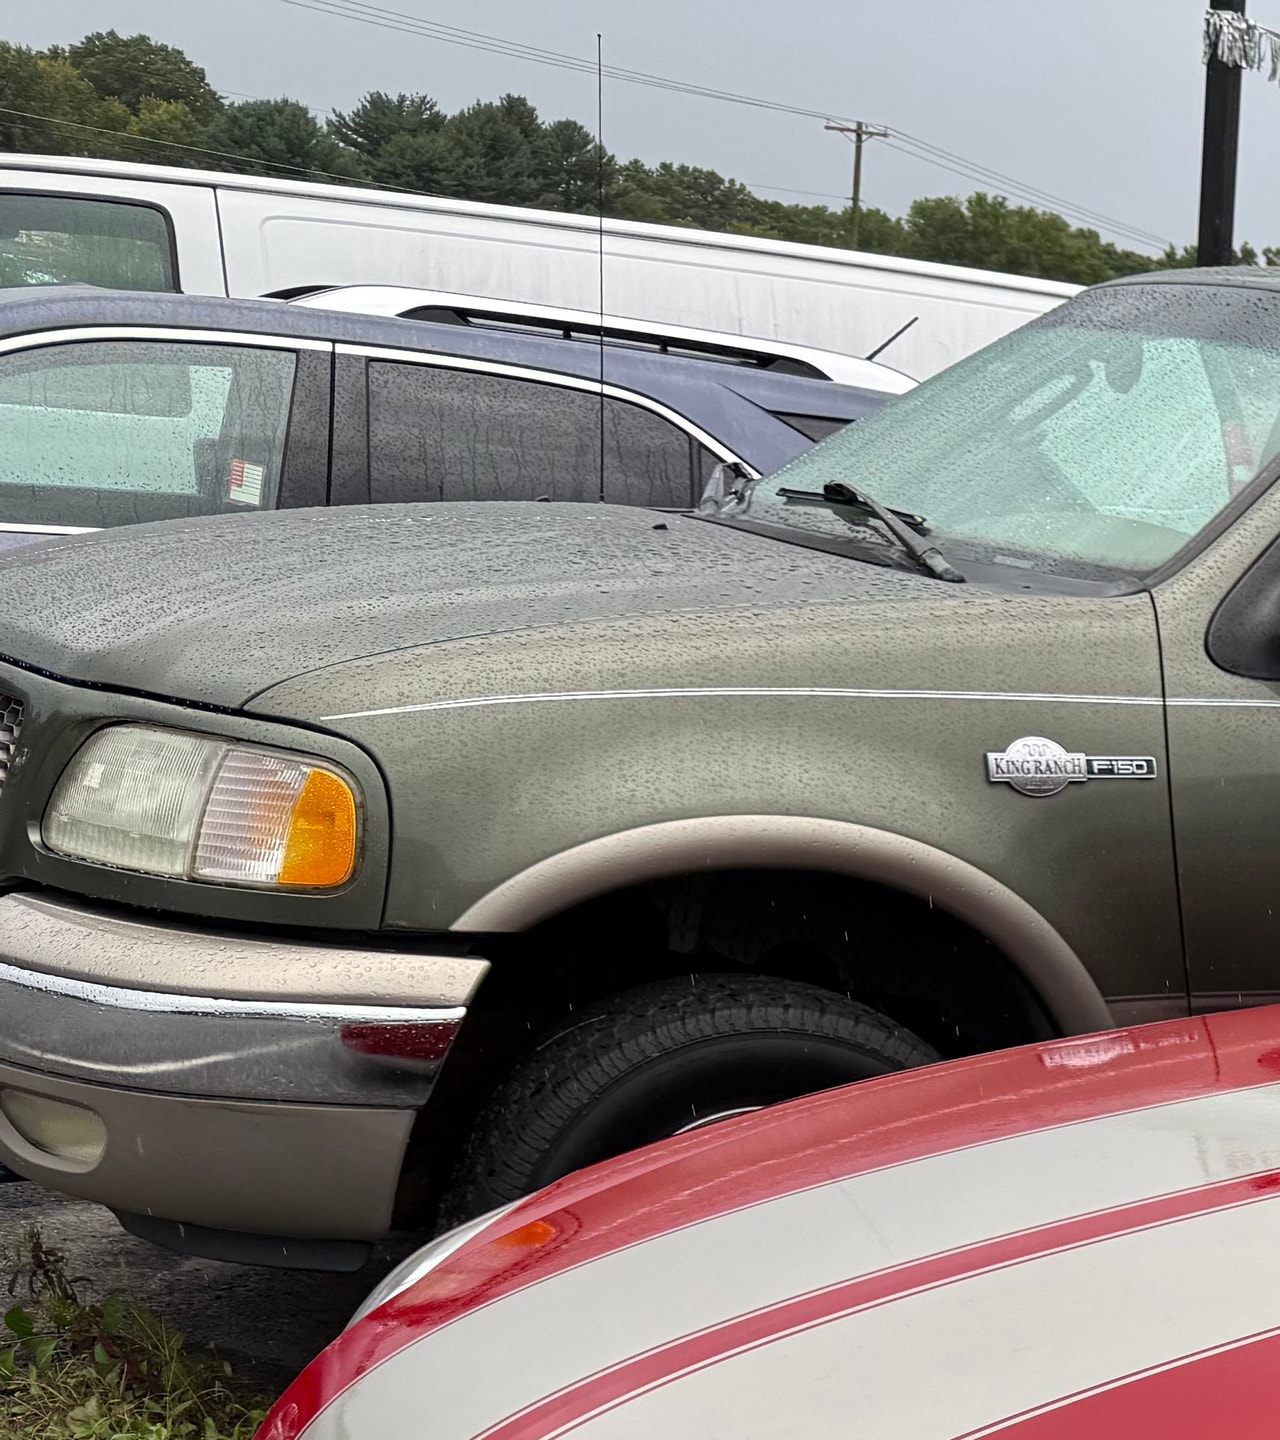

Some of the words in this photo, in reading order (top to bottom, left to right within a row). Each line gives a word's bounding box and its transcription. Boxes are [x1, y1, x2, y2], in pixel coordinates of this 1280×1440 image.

[994, 757, 1031, 776] KING
[1034, 757, 1083, 776] RANCH
[1092, 760, 1148, 775] F-150
